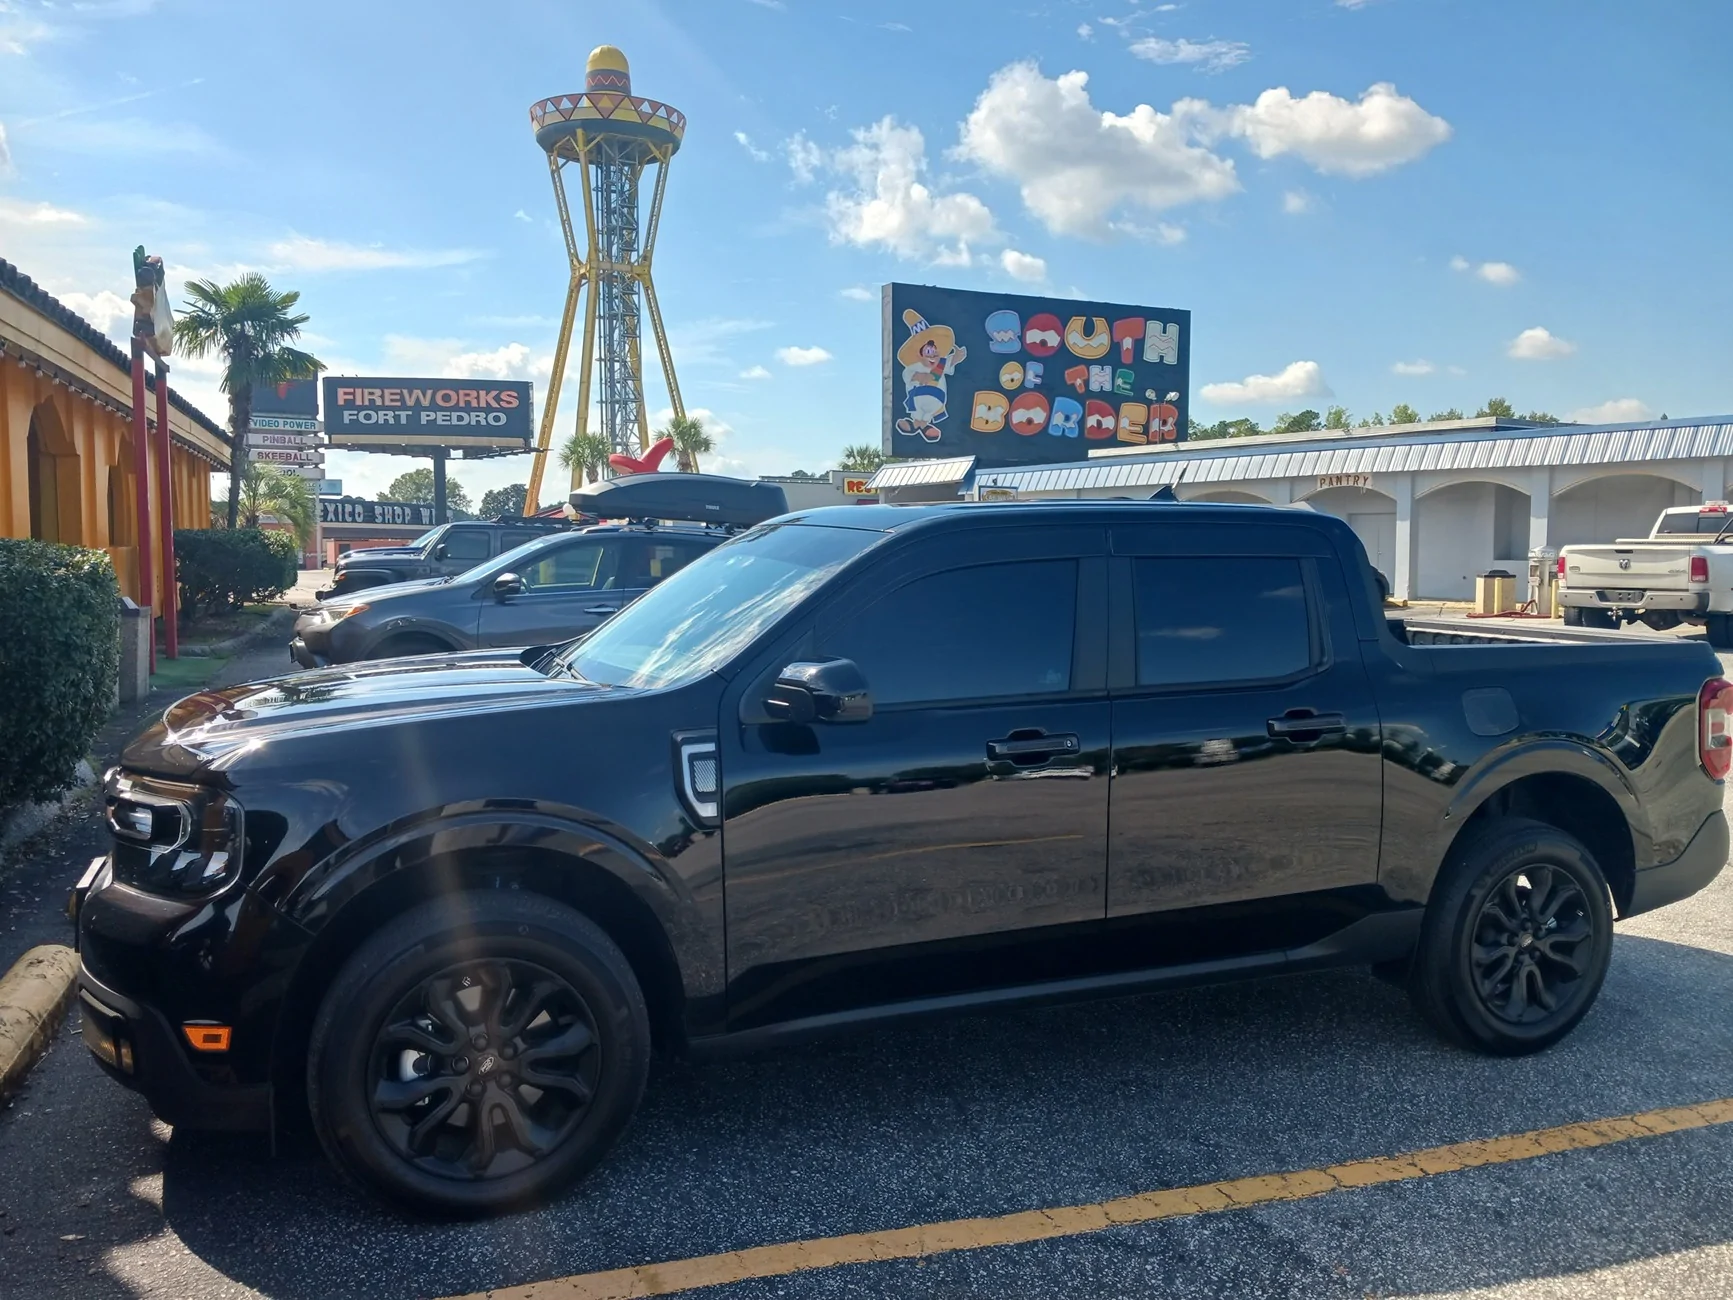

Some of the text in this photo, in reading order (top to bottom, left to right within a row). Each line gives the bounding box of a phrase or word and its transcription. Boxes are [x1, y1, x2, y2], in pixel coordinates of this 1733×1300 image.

[985, 310, 1180, 365] SOUTH
[999, 361, 1135, 397] OF THE
[337, 388, 520, 408] FIREWORKS
[253, 418, 316, 430] VIDEO POWER
[343, 410, 507, 426] FORT PEDRO
[970, 390, 1180, 445] BORDER
[262, 435, 307, 445] PINBALL
[257, 451, 313, 462] SKEEBALL
[847, 480, 878, 493] RES
[1319, 474, 1369, 489] PANTRY
[374, 505, 412, 525] SHOP
